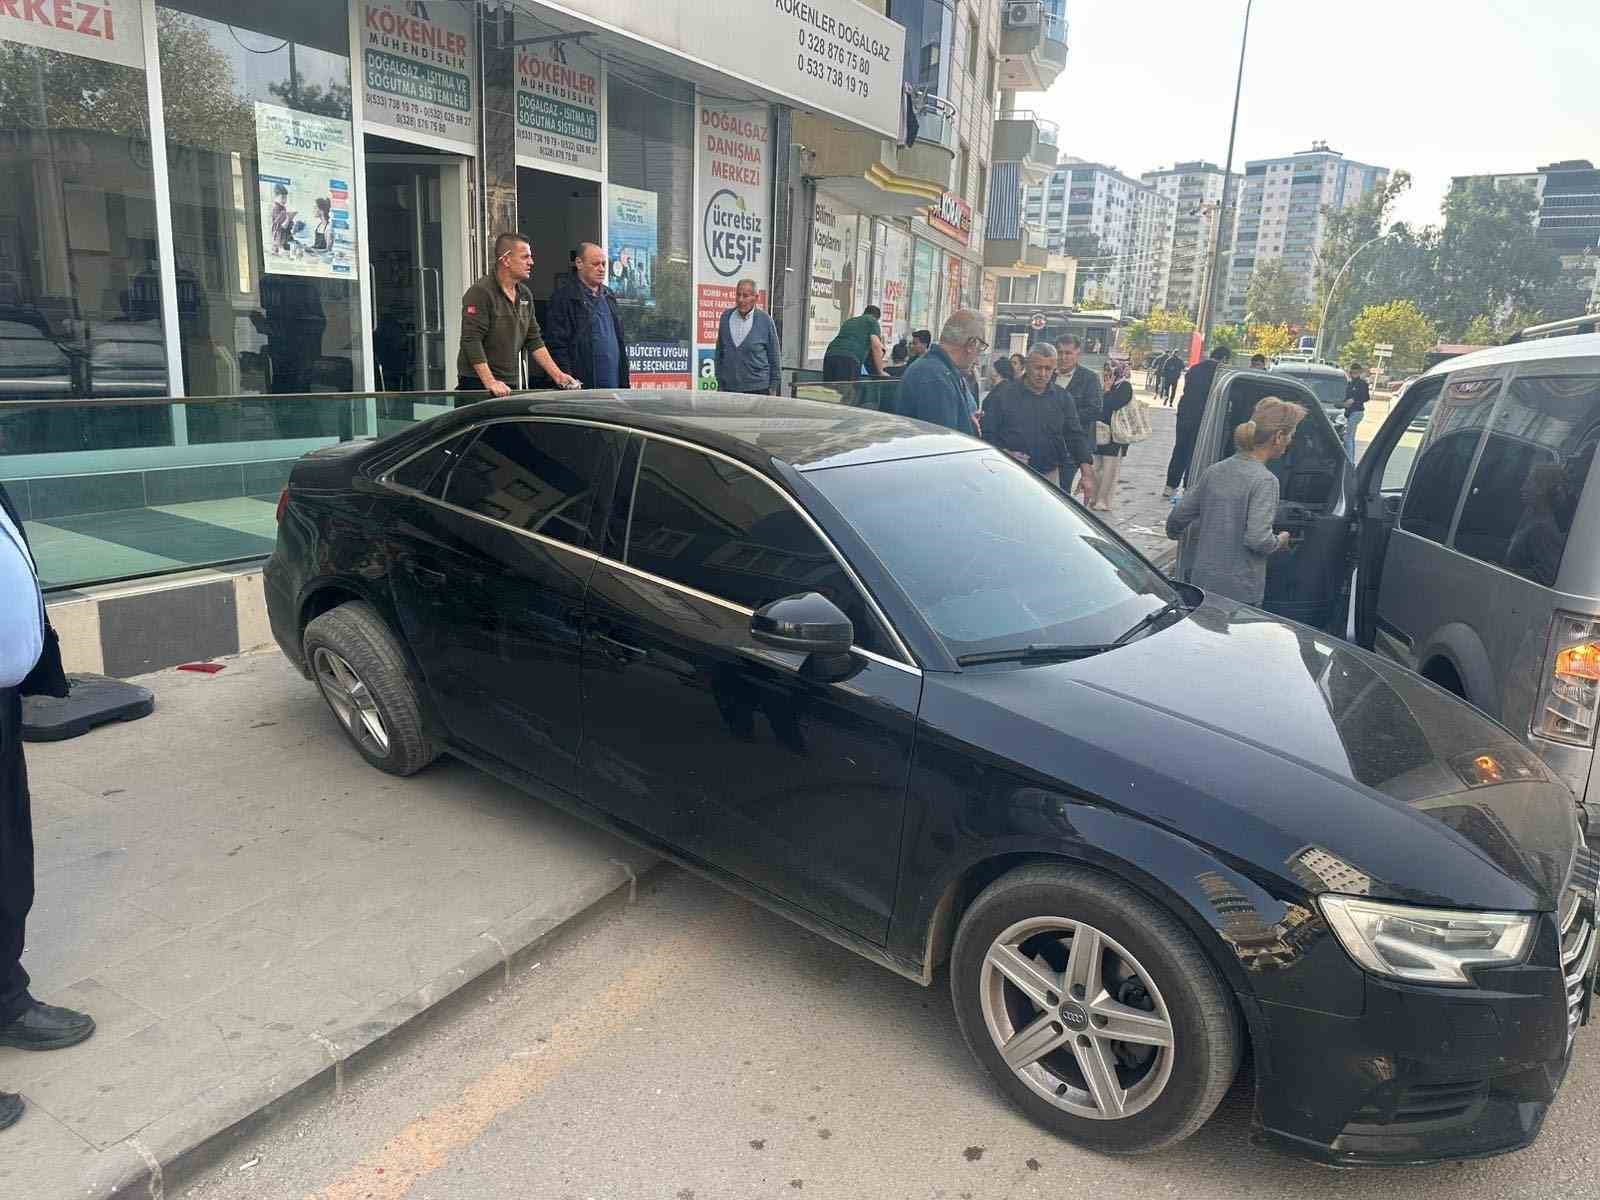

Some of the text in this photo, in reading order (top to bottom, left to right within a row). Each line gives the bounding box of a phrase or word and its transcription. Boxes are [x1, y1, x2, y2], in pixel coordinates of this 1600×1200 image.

[367, 4, 466, 57] KÖKENLER
[838, 22, 890, 62] DOĞALGAZ
[799, 28, 870, 75] 0 328 876 75 80
[456, 78, 467, 93] VE
[518, 53, 597, 95] KÖKENLER
[797, 54, 869, 98] 0 533 738 19 79
[519, 95, 558, 117] DOĞALGAZ
[586, 112, 596, 126] VE
[519, 110, 556, 129] SOĞUTMA
[702, 108, 768, 144] DOĞALGAZ
[284, 134, 312, 149] 2.700
[707, 134, 761, 165] DANIŞMA
[711, 159, 761, 186] MERKEZİ
[713, 203, 762, 233] ücretsiz
[662, 346, 688, 358] UYGUN
